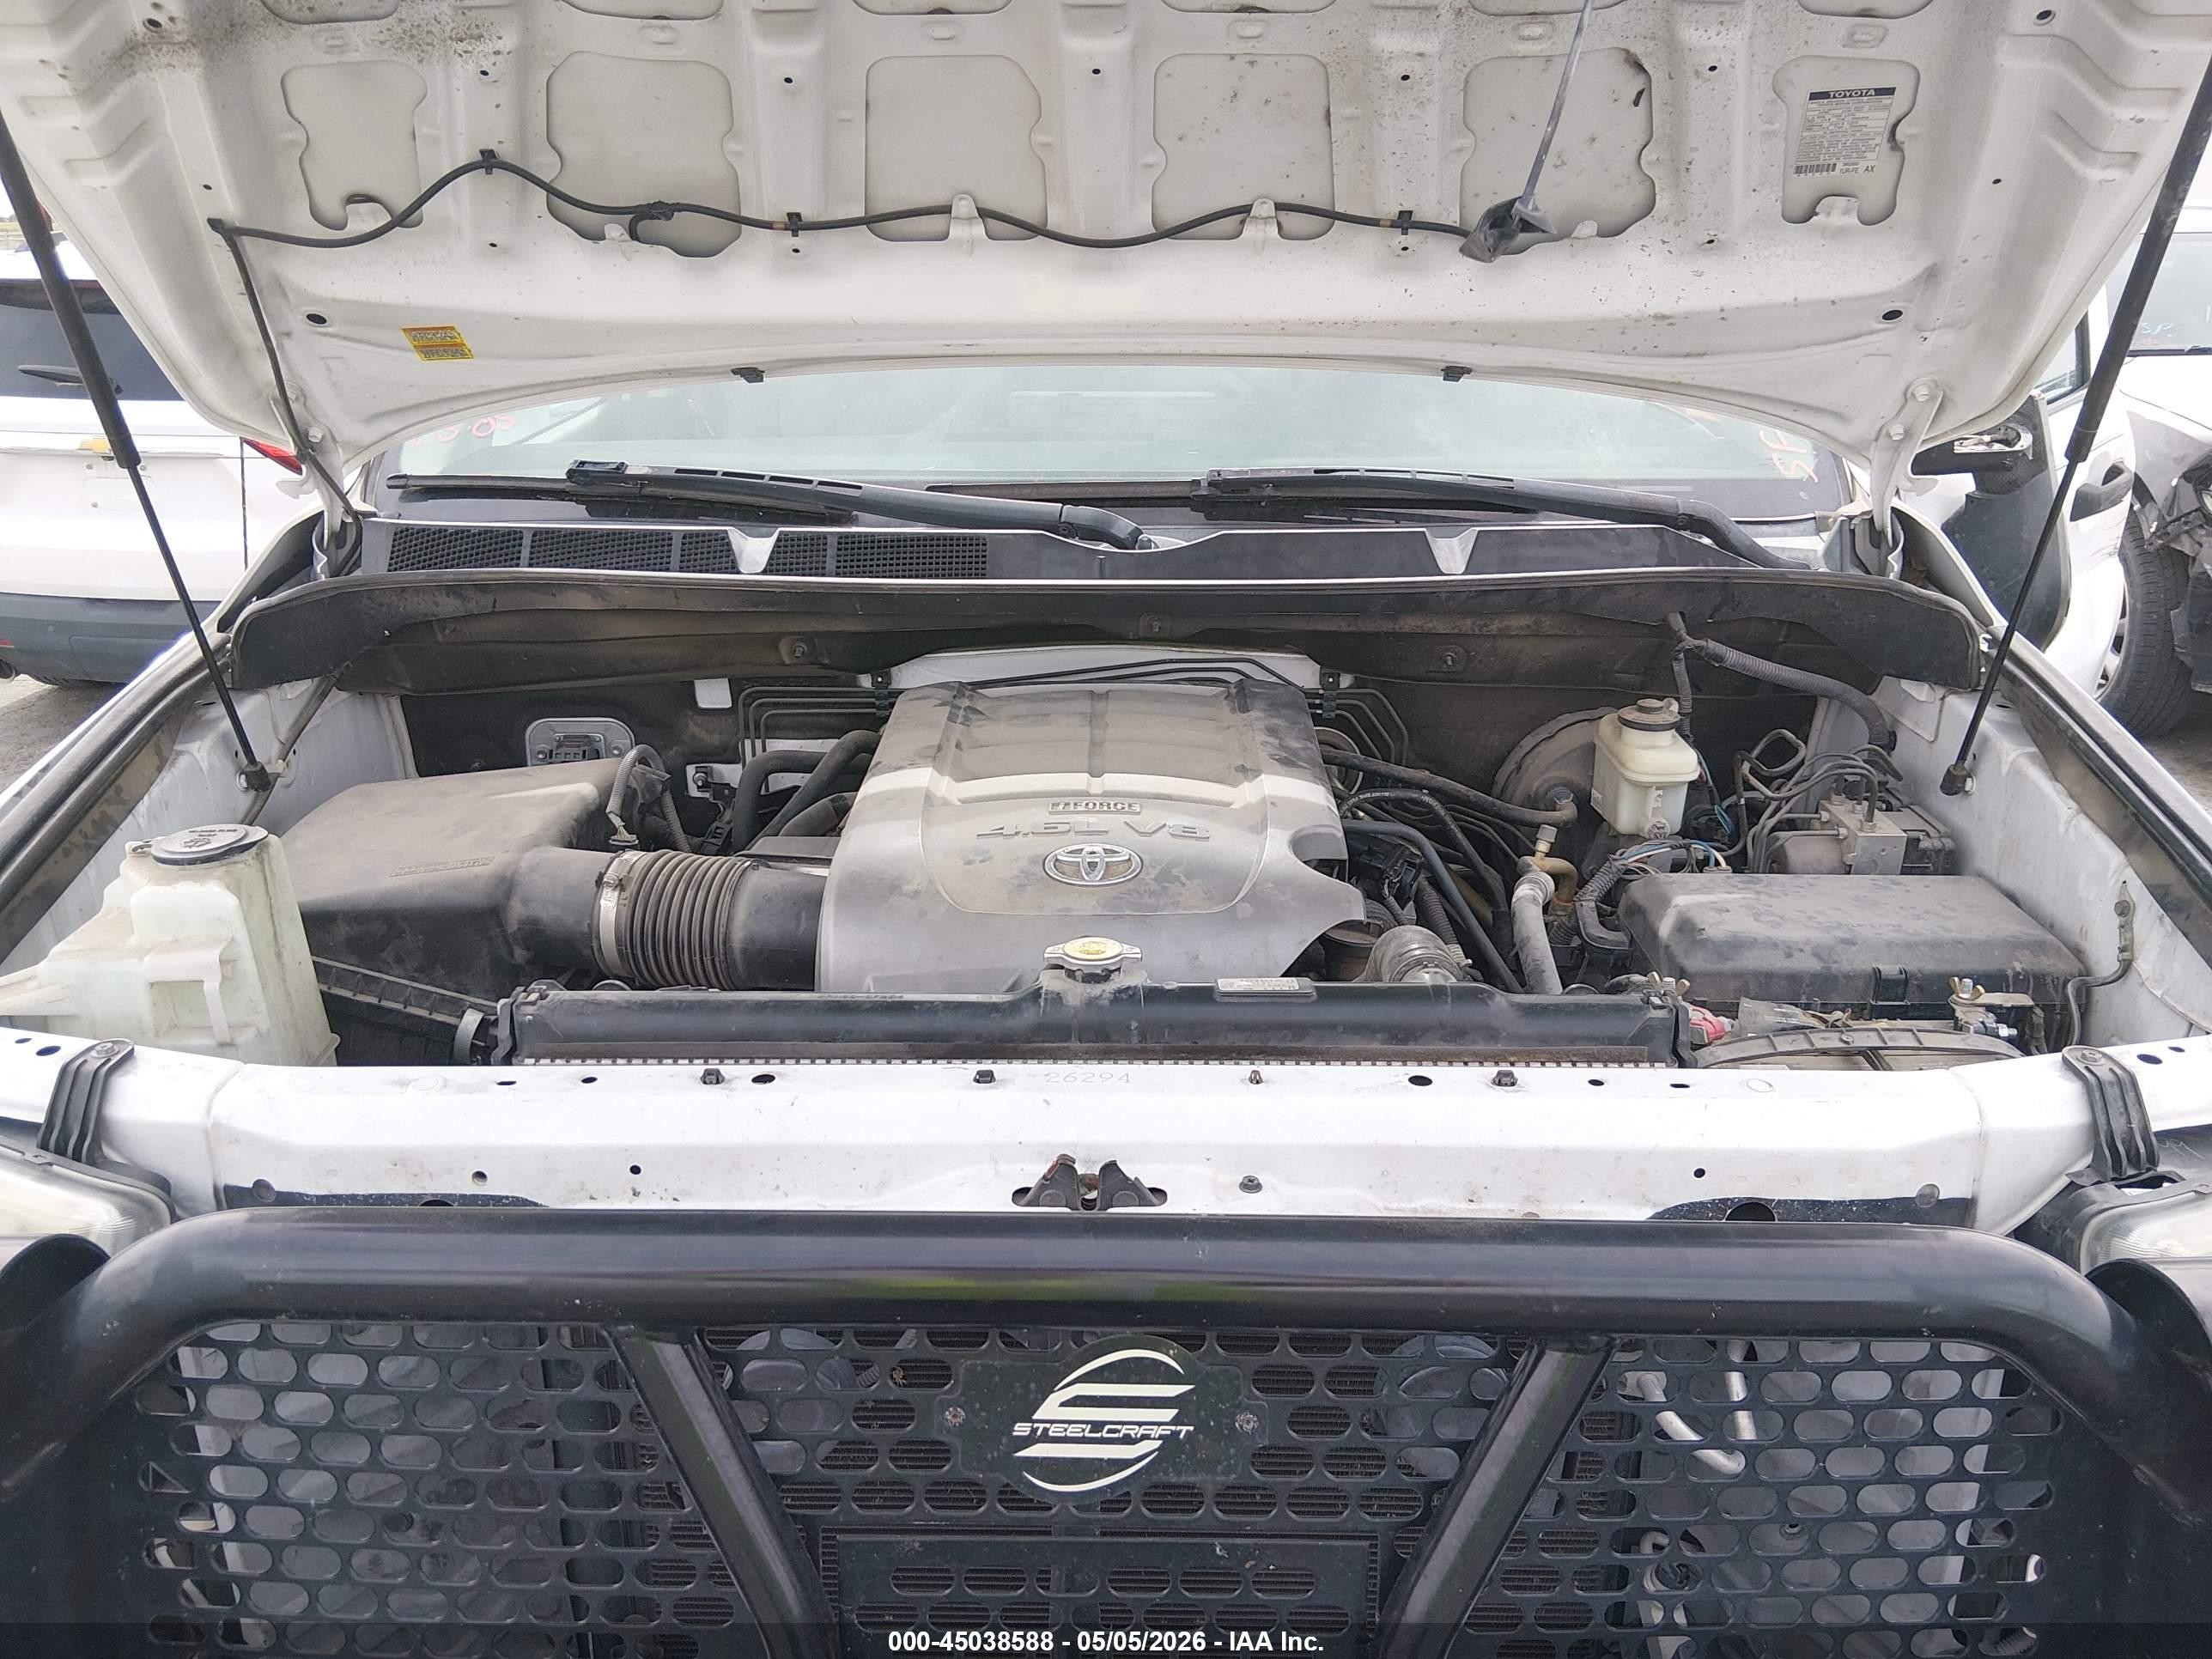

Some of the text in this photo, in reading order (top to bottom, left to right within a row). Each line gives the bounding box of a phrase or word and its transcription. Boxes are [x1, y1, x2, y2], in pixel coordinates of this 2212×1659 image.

[1828, 88, 1875, 98] TOYOTA
[1863, 164, 1876, 173] AX
[1043, 1071, 1133, 1084] 26294
[1012, 1422, 1194, 1440] STEELCRAFT
